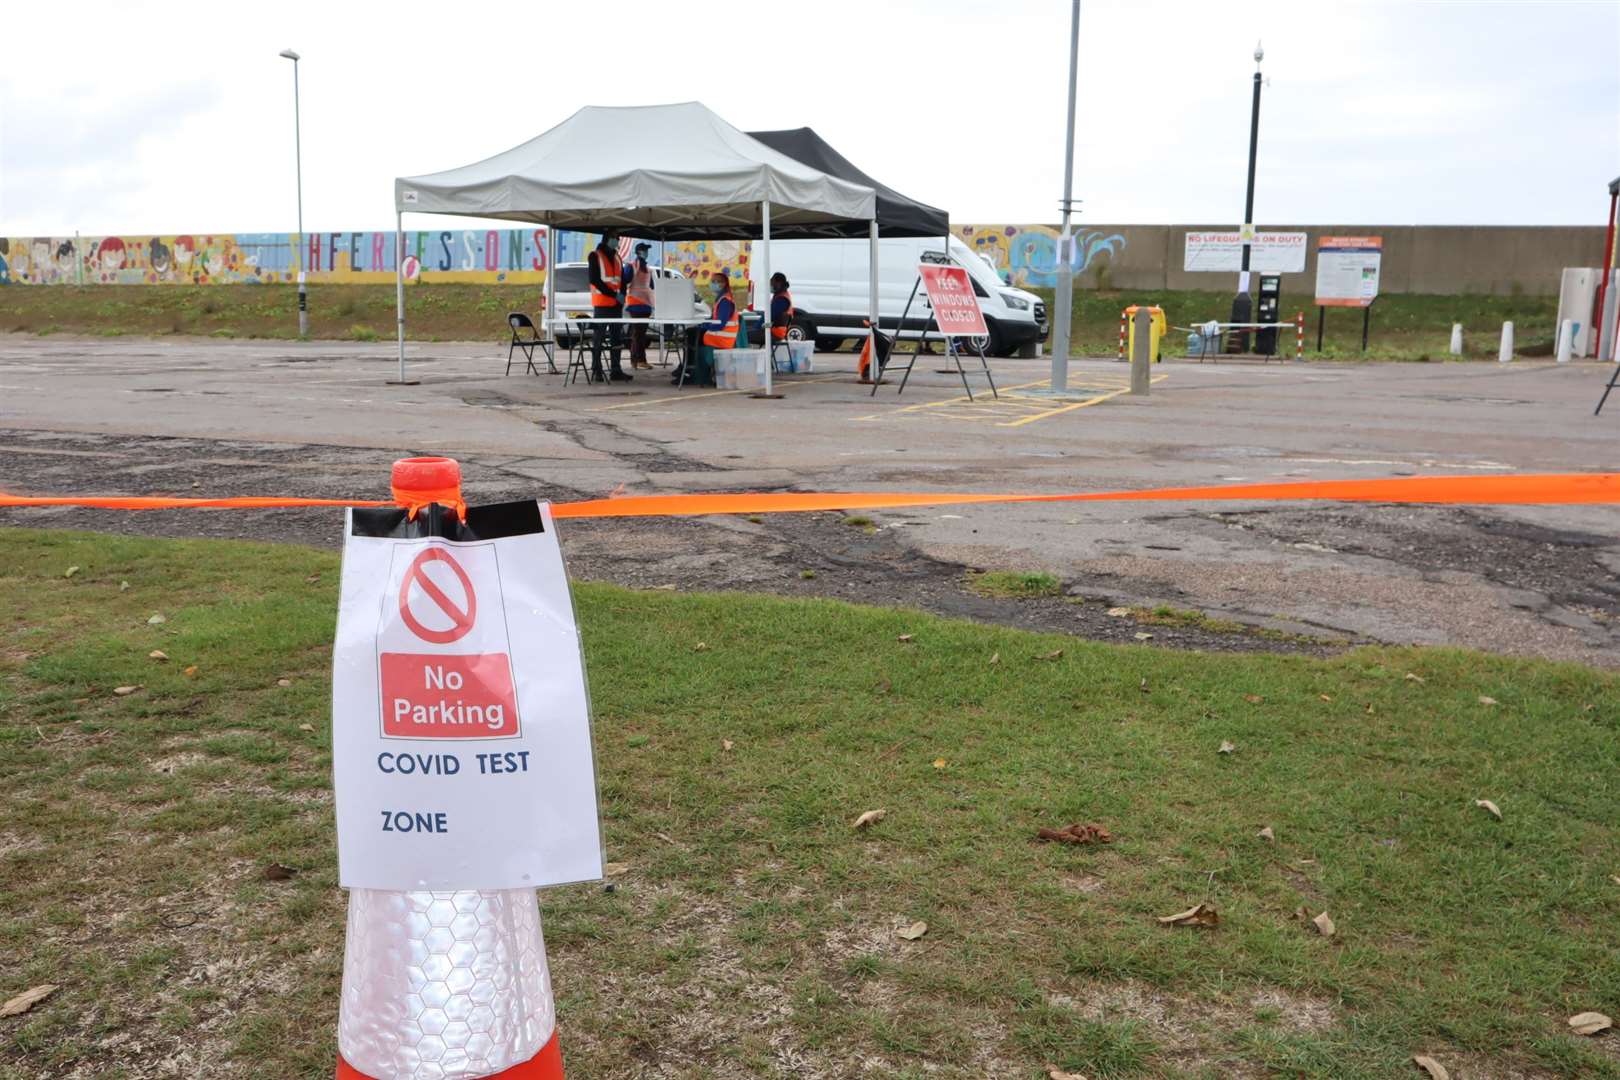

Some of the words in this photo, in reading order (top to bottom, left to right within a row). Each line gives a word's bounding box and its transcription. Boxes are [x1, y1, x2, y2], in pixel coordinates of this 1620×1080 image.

[1278, 234, 1303, 242] DUTY
[932, 294, 975, 307] WINDOWS
[941, 309, 976, 322] CLOSED
[424, 665, 464, 690] No
[393, 698, 505, 729] Parking
[377, 752, 460, 775] COVID
[475, 751, 530, 774] TEST
[381, 811, 448, 832] ZONE
